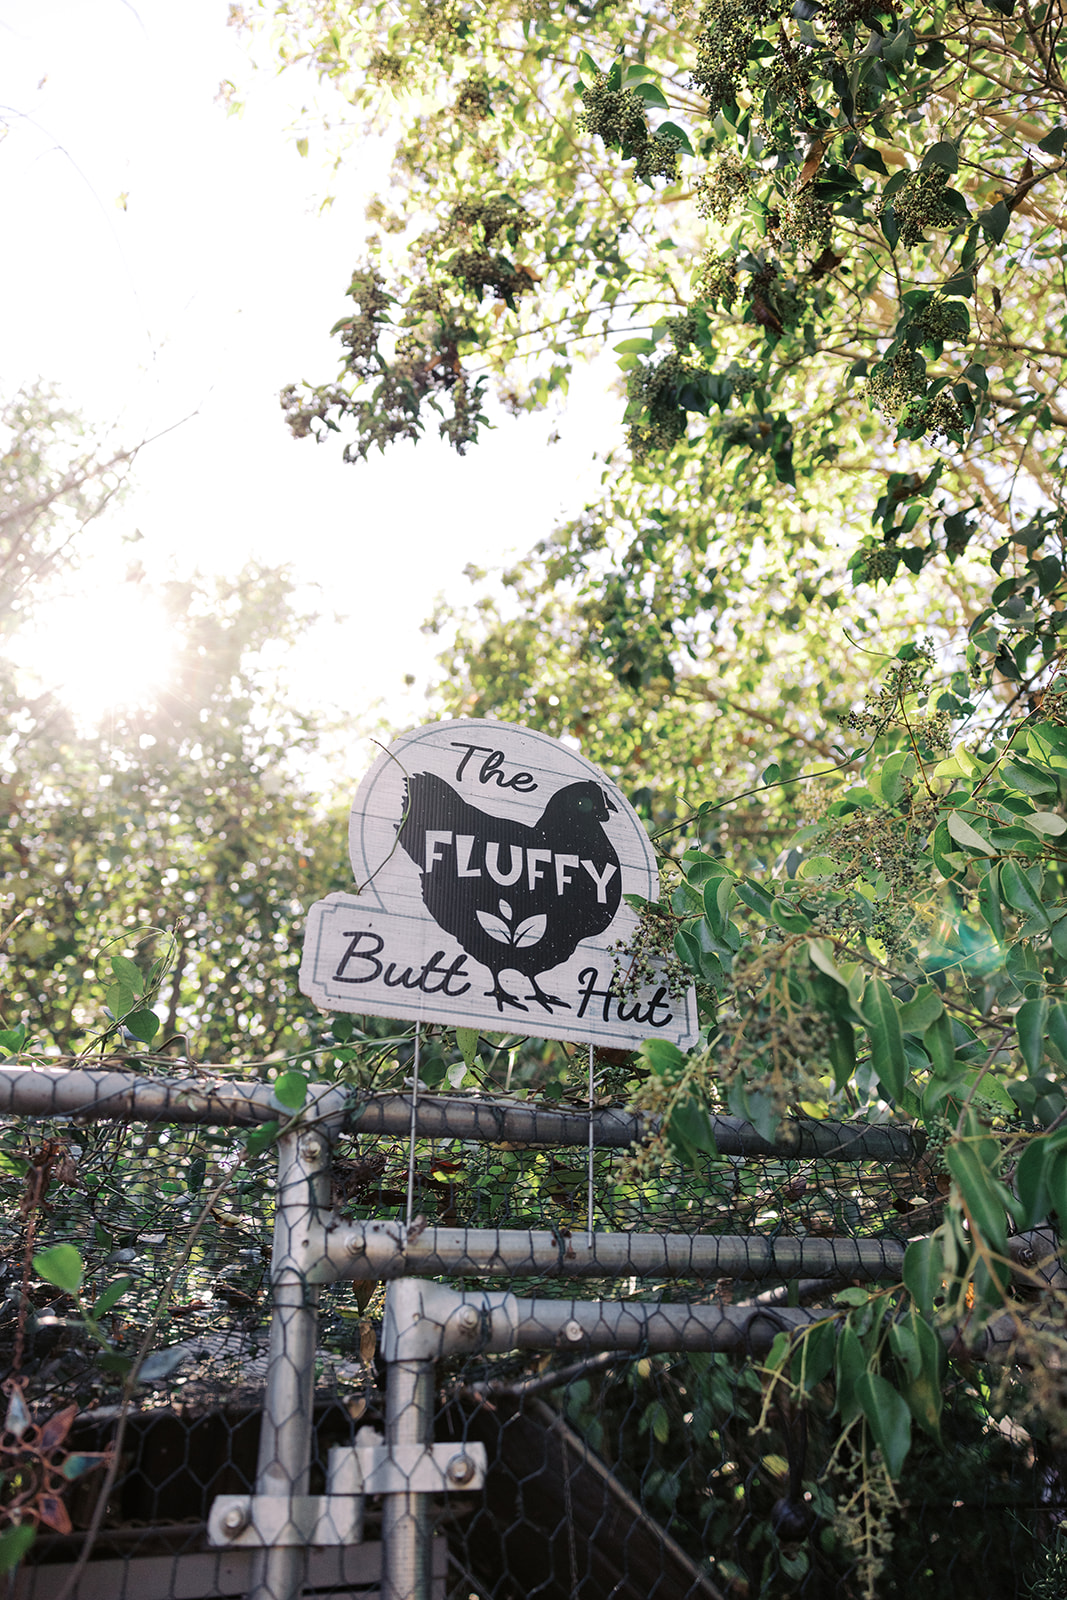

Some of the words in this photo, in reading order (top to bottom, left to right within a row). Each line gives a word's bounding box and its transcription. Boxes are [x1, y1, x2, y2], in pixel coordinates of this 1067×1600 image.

[450, 741, 538, 793] The
[425, 830, 618, 904] FLUFFY
[332, 931, 472, 997] Butt
[576, 966, 674, 1028] Hut
